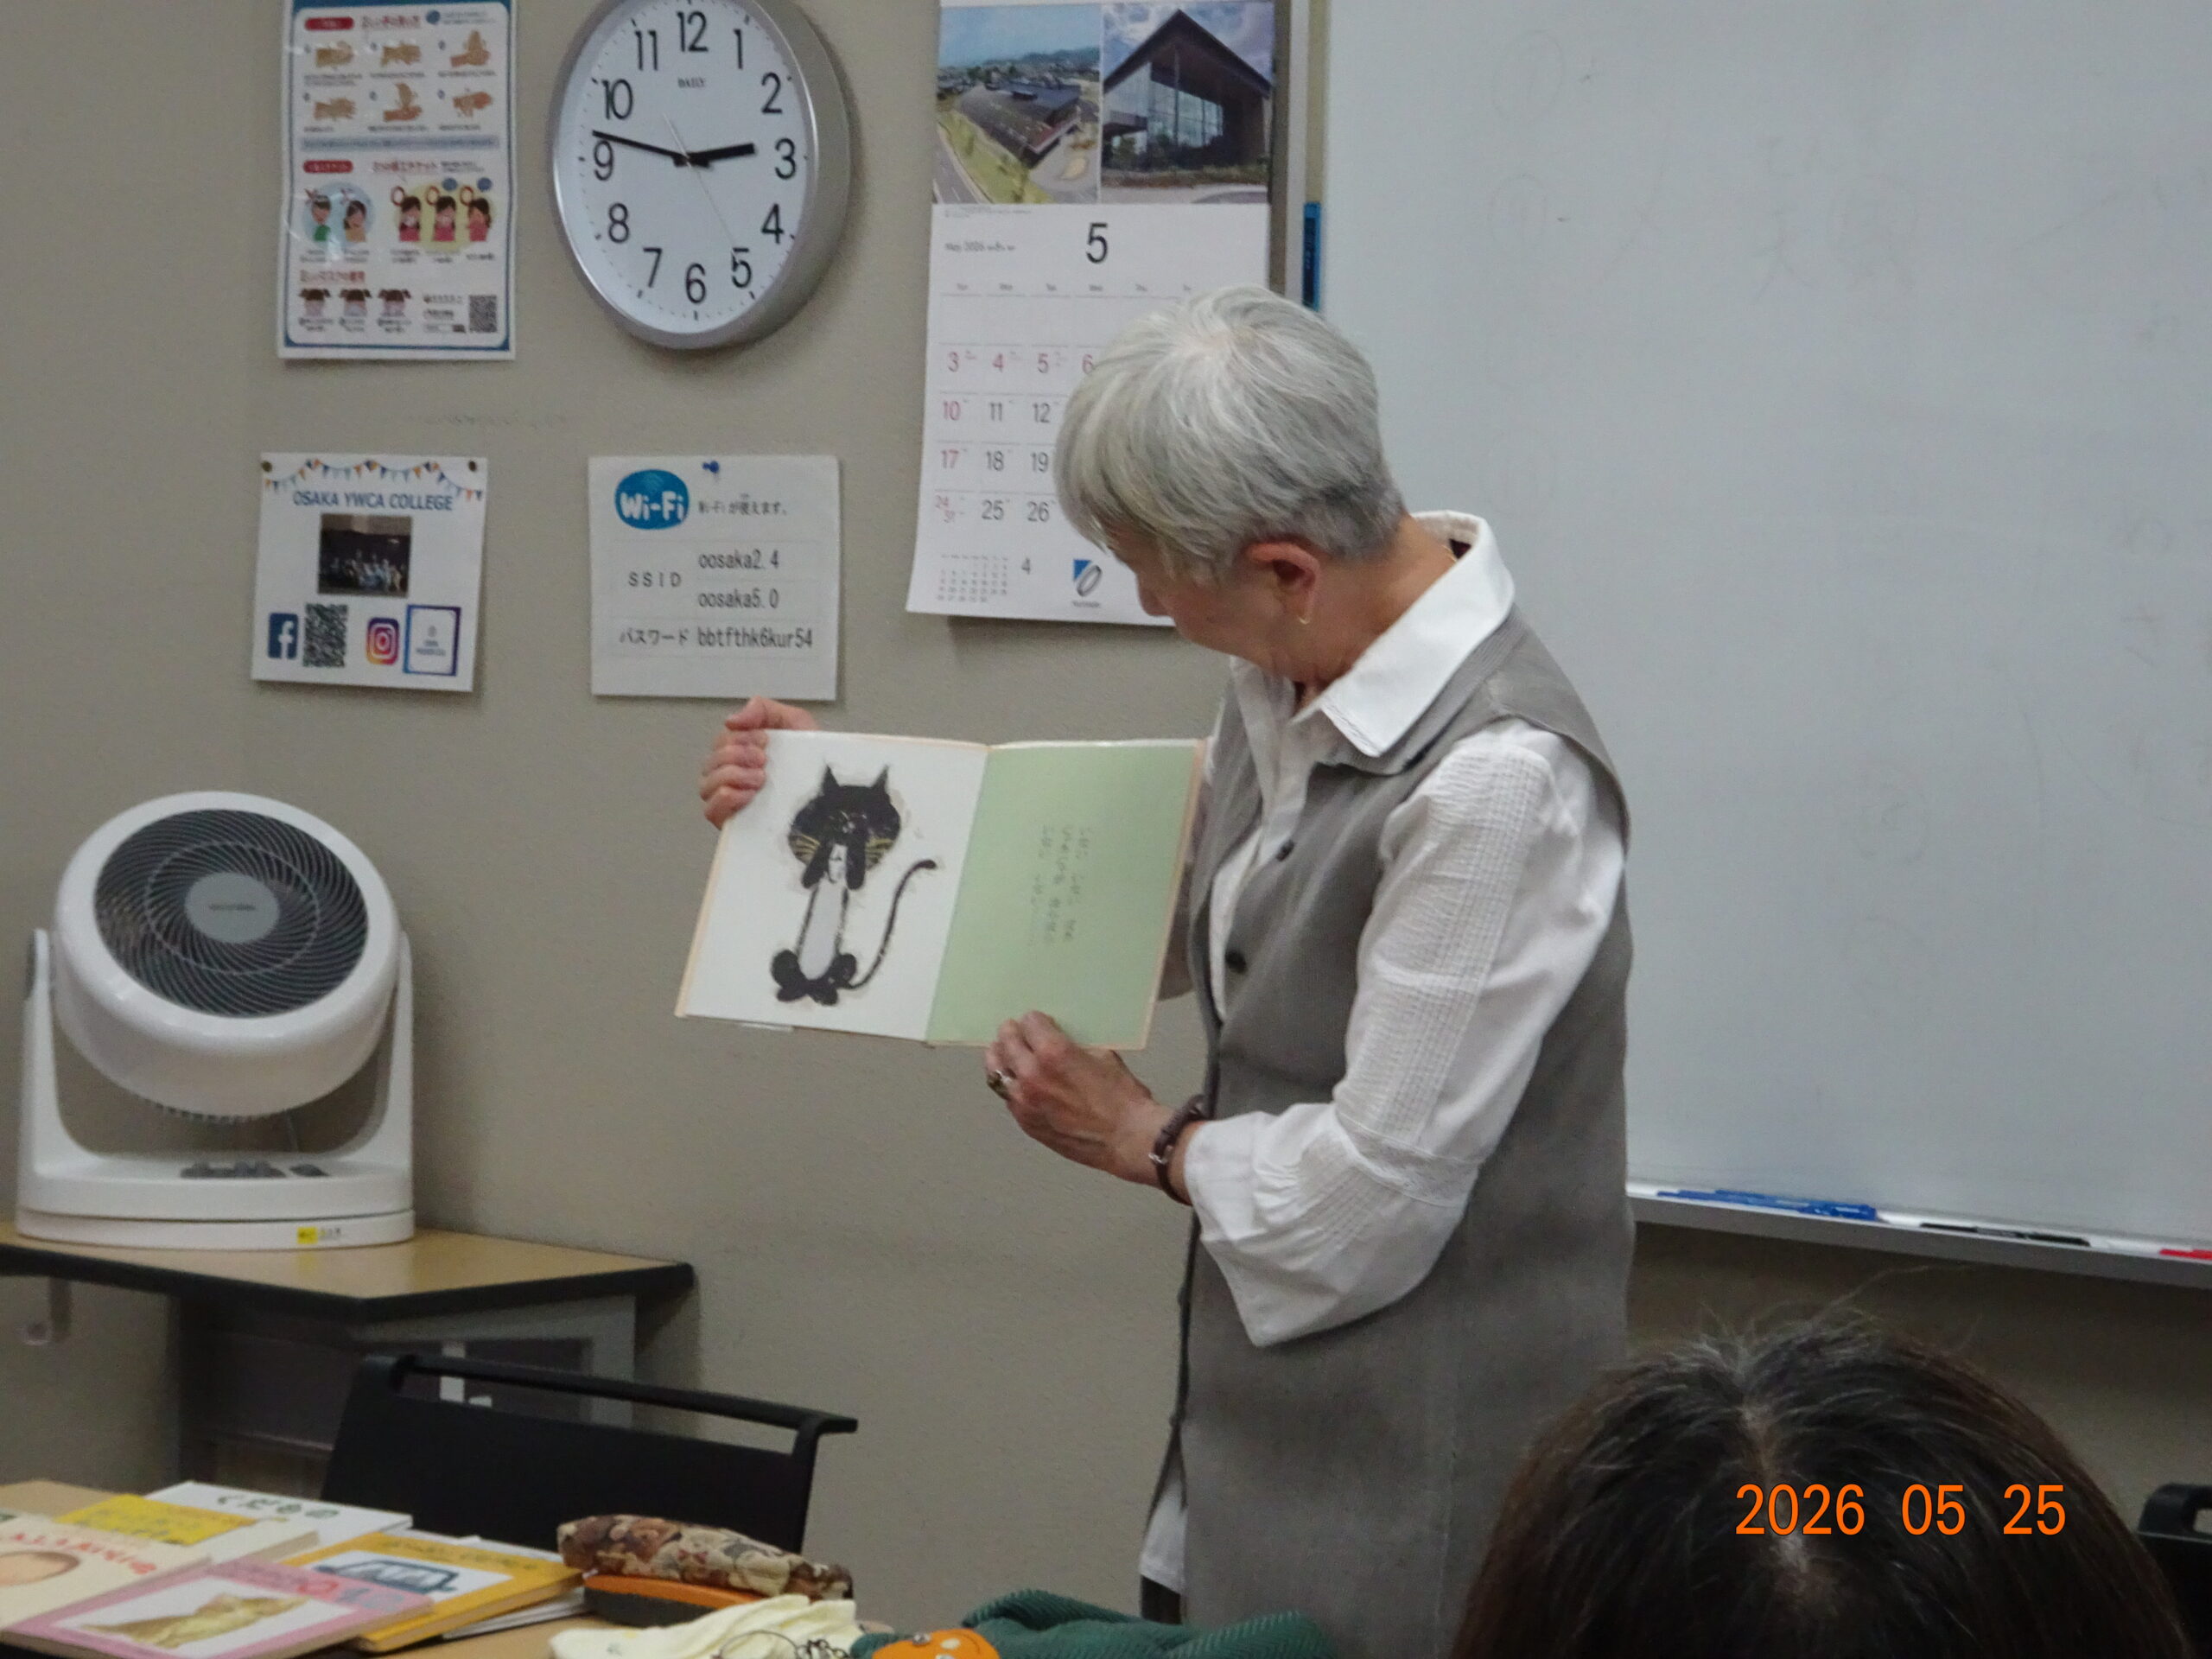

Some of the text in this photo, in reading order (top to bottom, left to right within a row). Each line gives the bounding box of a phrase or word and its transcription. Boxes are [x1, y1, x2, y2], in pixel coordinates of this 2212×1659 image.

[635, 29, 658, 70] 11
[677, 11, 709, 52] 12
[734, 29, 743, 69] 1
[601, 79, 632, 119] 10
[761, 73, 783, 113] 2
[594, 140, 613, 181] 9
[775, 138, 796, 180] 3
[608, 203, 629, 243] 8
[761, 204, 784, 244] 4
[1086, 222, 1108, 264] 5
[643, 247, 662, 287] 7
[685, 264, 706, 302] 6
[731, 248, 752, 288] 5
[948, 352, 959, 372] 3
[993, 353, 1004, 372] 4
[1038, 353, 1049, 373] 5
[1082, 353, 1094, 374] 6
[943, 400, 1050, 423] 10 11 12
[940, 450, 1048, 472] 17 18 19
[293, 491, 453, 511] OSAKA YWCA COLLEGE
[620, 491, 684, 520] Wi-Fi
[982, 499, 1004, 520] 25
[1027, 501, 1049, 522] 26
[628, 572, 682, 588] SSID
[1021, 557, 1031, 575] 4
[620, 628, 690, 645] パスワード
